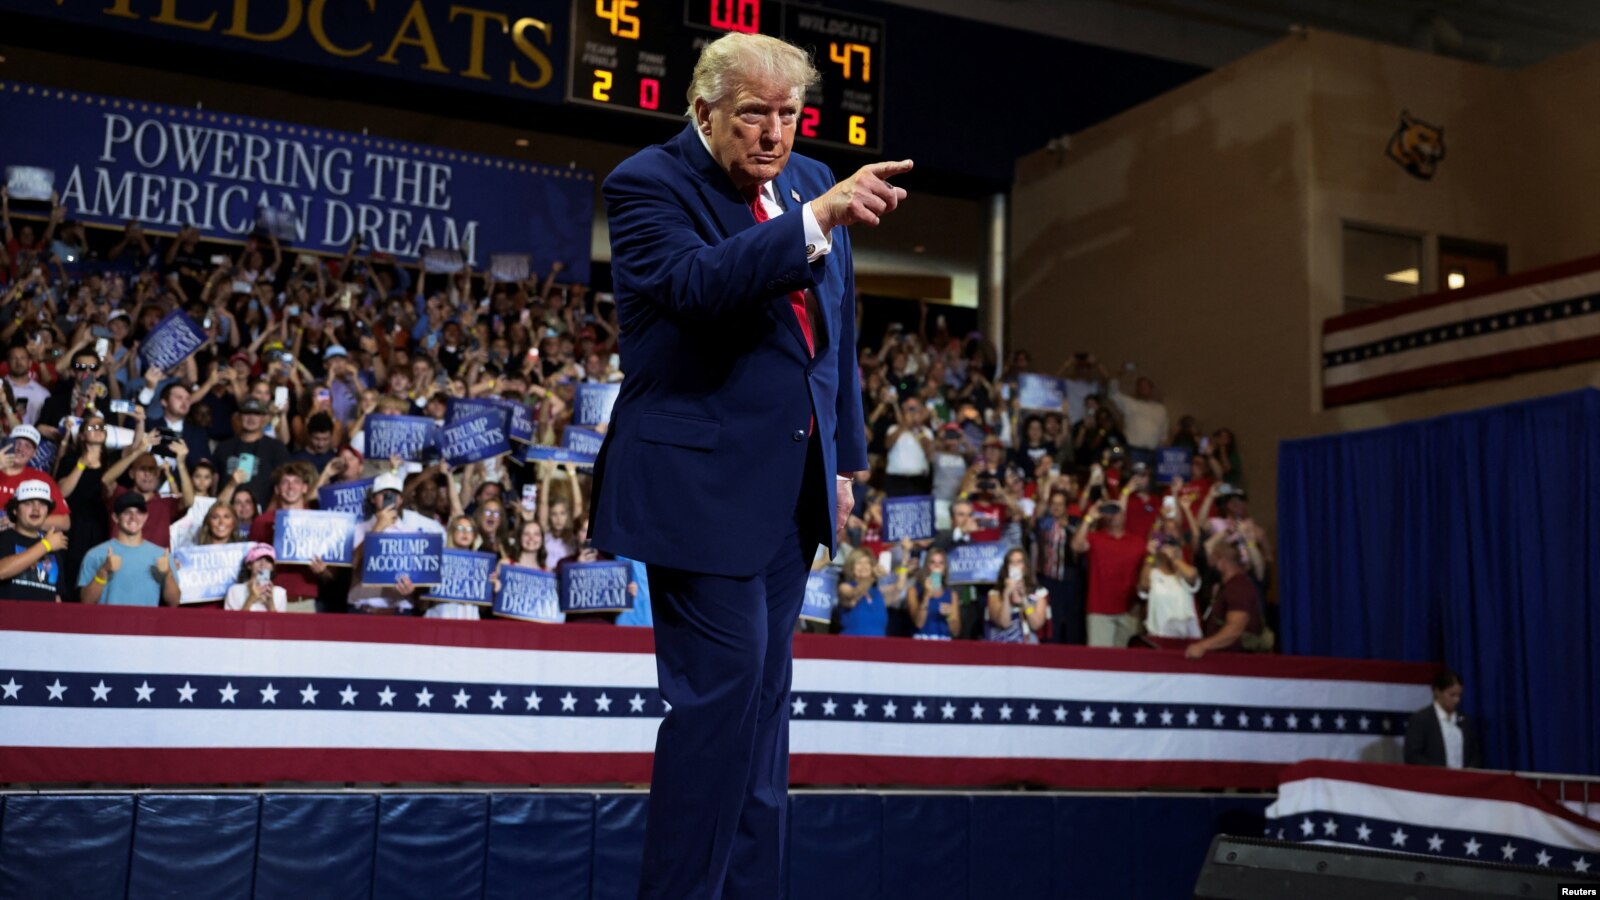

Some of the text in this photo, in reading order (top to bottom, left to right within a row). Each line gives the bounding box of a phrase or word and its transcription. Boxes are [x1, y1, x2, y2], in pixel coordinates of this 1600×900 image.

[596, 0, 640, 40] 45
[798, 13, 880, 43] WILDCATS
[829, 42, 871, 83] 47
[593, 69, 613, 102] 2
[640, 78, 660, 110] 0
[801, 107, 820, 138] 2
[848, 115, 867, 146] 6
[100, 113, 354, 197] POWERING
[364, 152, 452, 211] THE
[321, 198, 479, 267] DREAM
[444, 417, 488, 444] TRUMP
[333, 485, 367, 505] TRUM
[379, 538, 429, 555] TRUMP
[366, 553, 440, 572] ACCOUNTS
[569, 576, 628, 592] AMERICAN
[569, 588, 627, 608] DREAM
[501, 591, 559, 619] DREAM
